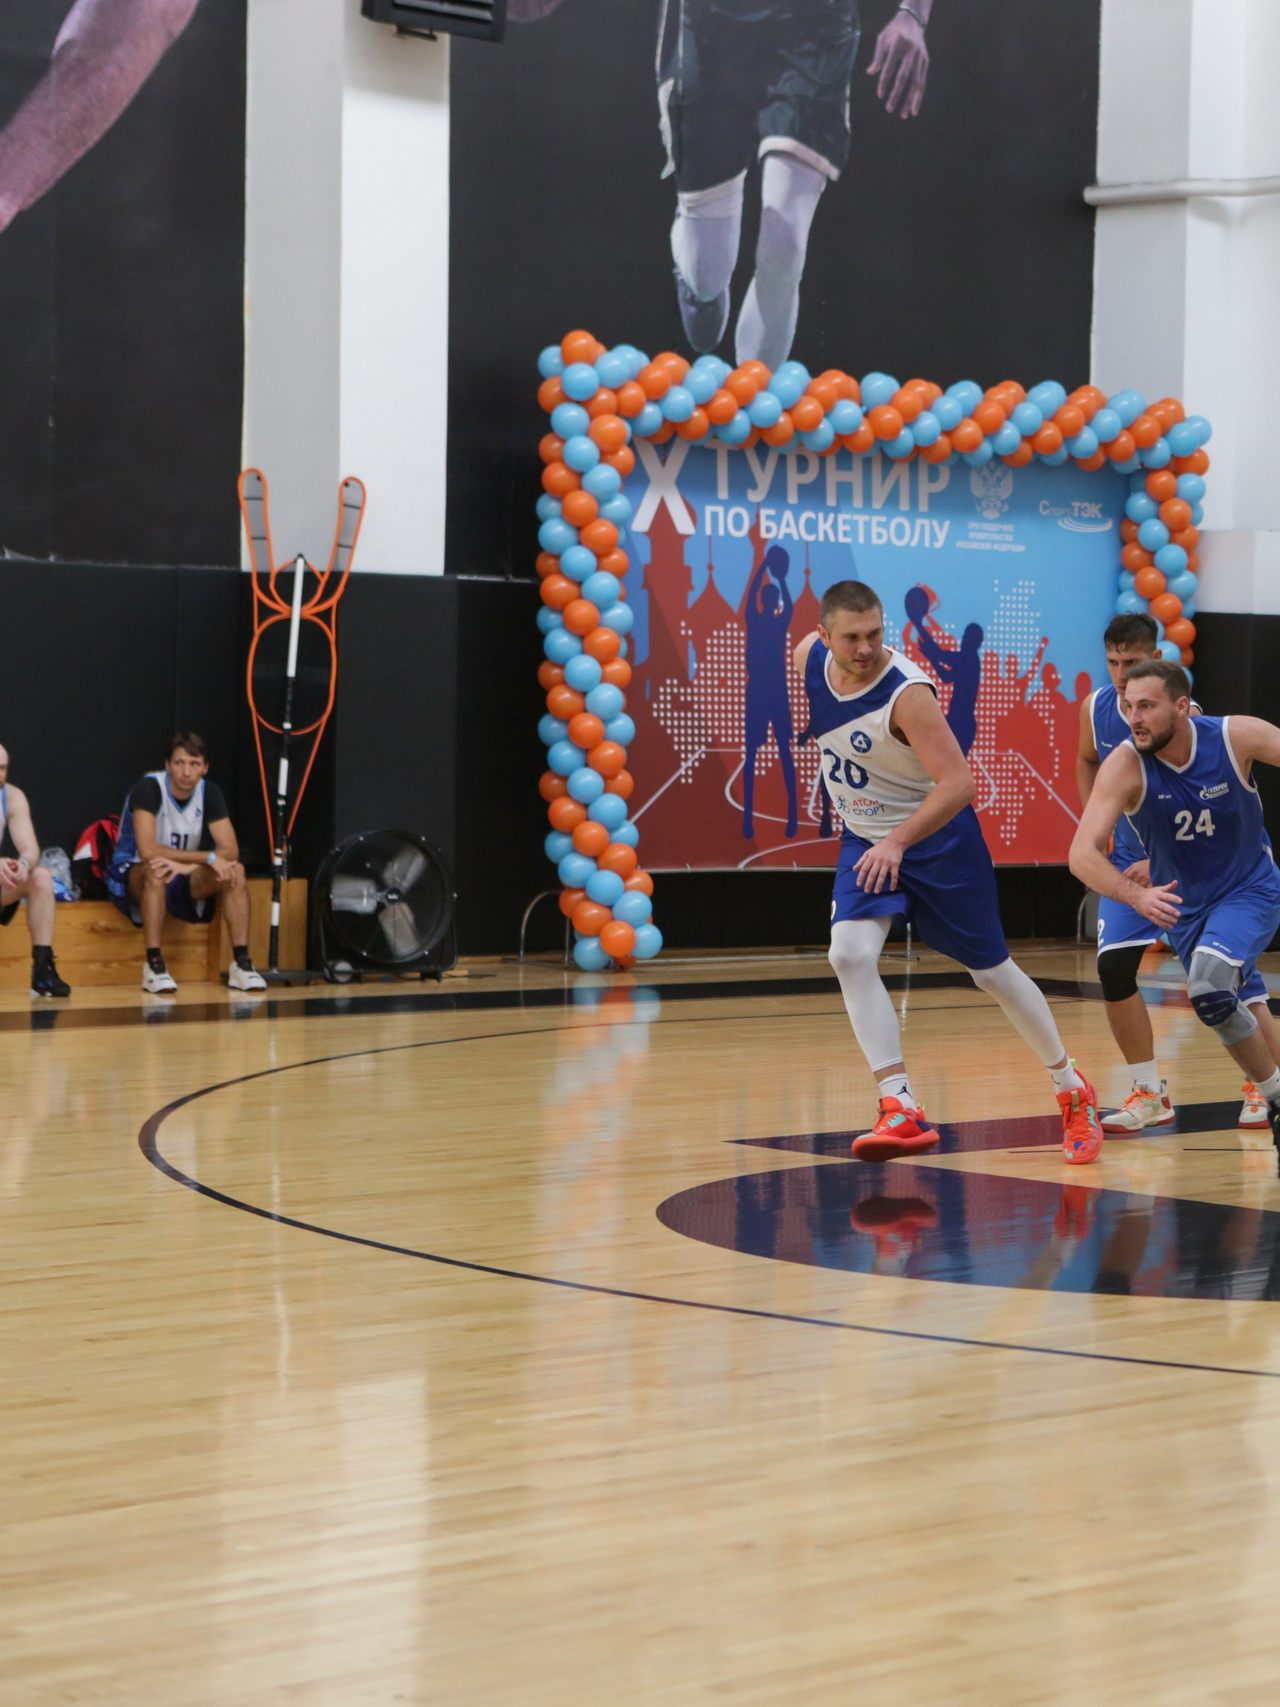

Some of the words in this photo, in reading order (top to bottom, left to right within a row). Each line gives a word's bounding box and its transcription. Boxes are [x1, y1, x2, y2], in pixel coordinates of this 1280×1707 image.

[704, 439, 951, 512] ТУРНИР
[705, 505, 750, 538] ПО
[759, 508, 951, 548] БАСКЕТБОЛУ
[823, 748, 870, 789] 20
[1174, 808, 1216, 841] 24
